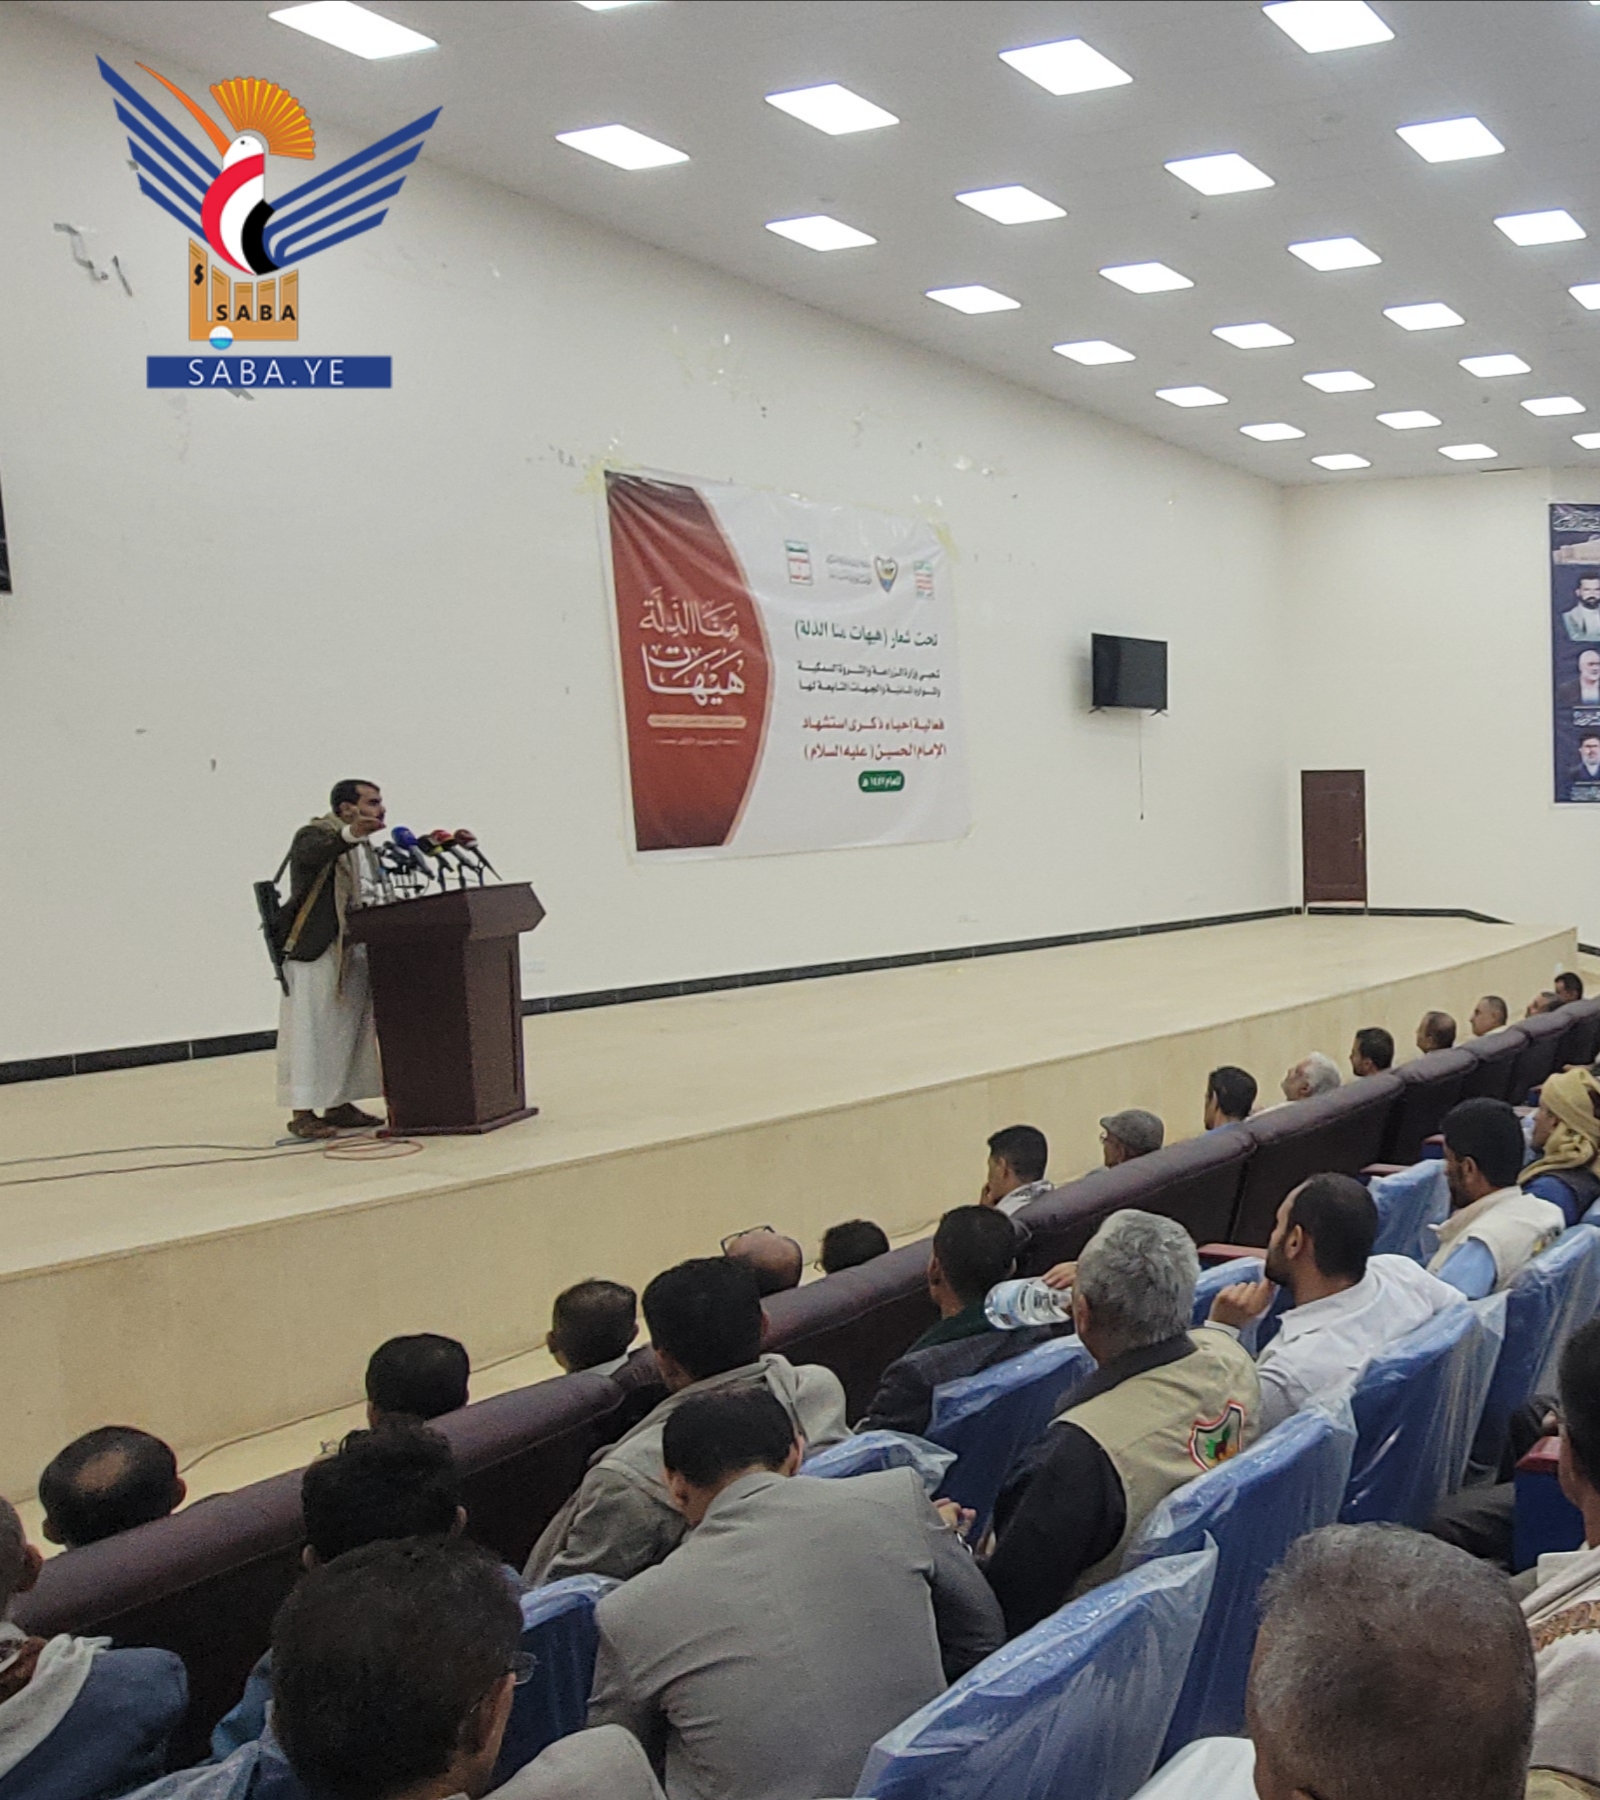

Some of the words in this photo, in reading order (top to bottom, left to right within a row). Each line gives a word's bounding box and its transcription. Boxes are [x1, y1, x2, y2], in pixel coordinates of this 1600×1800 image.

[890, 628, 911, 649] شعار
[914, 631, 938, 647] تحت
[798, 679, 817, 692] لها
[802, 714, 848, 731] استشهاد
[912, 717, 945, 732] فعالية
[875, 742, 917, 760] الحسين
